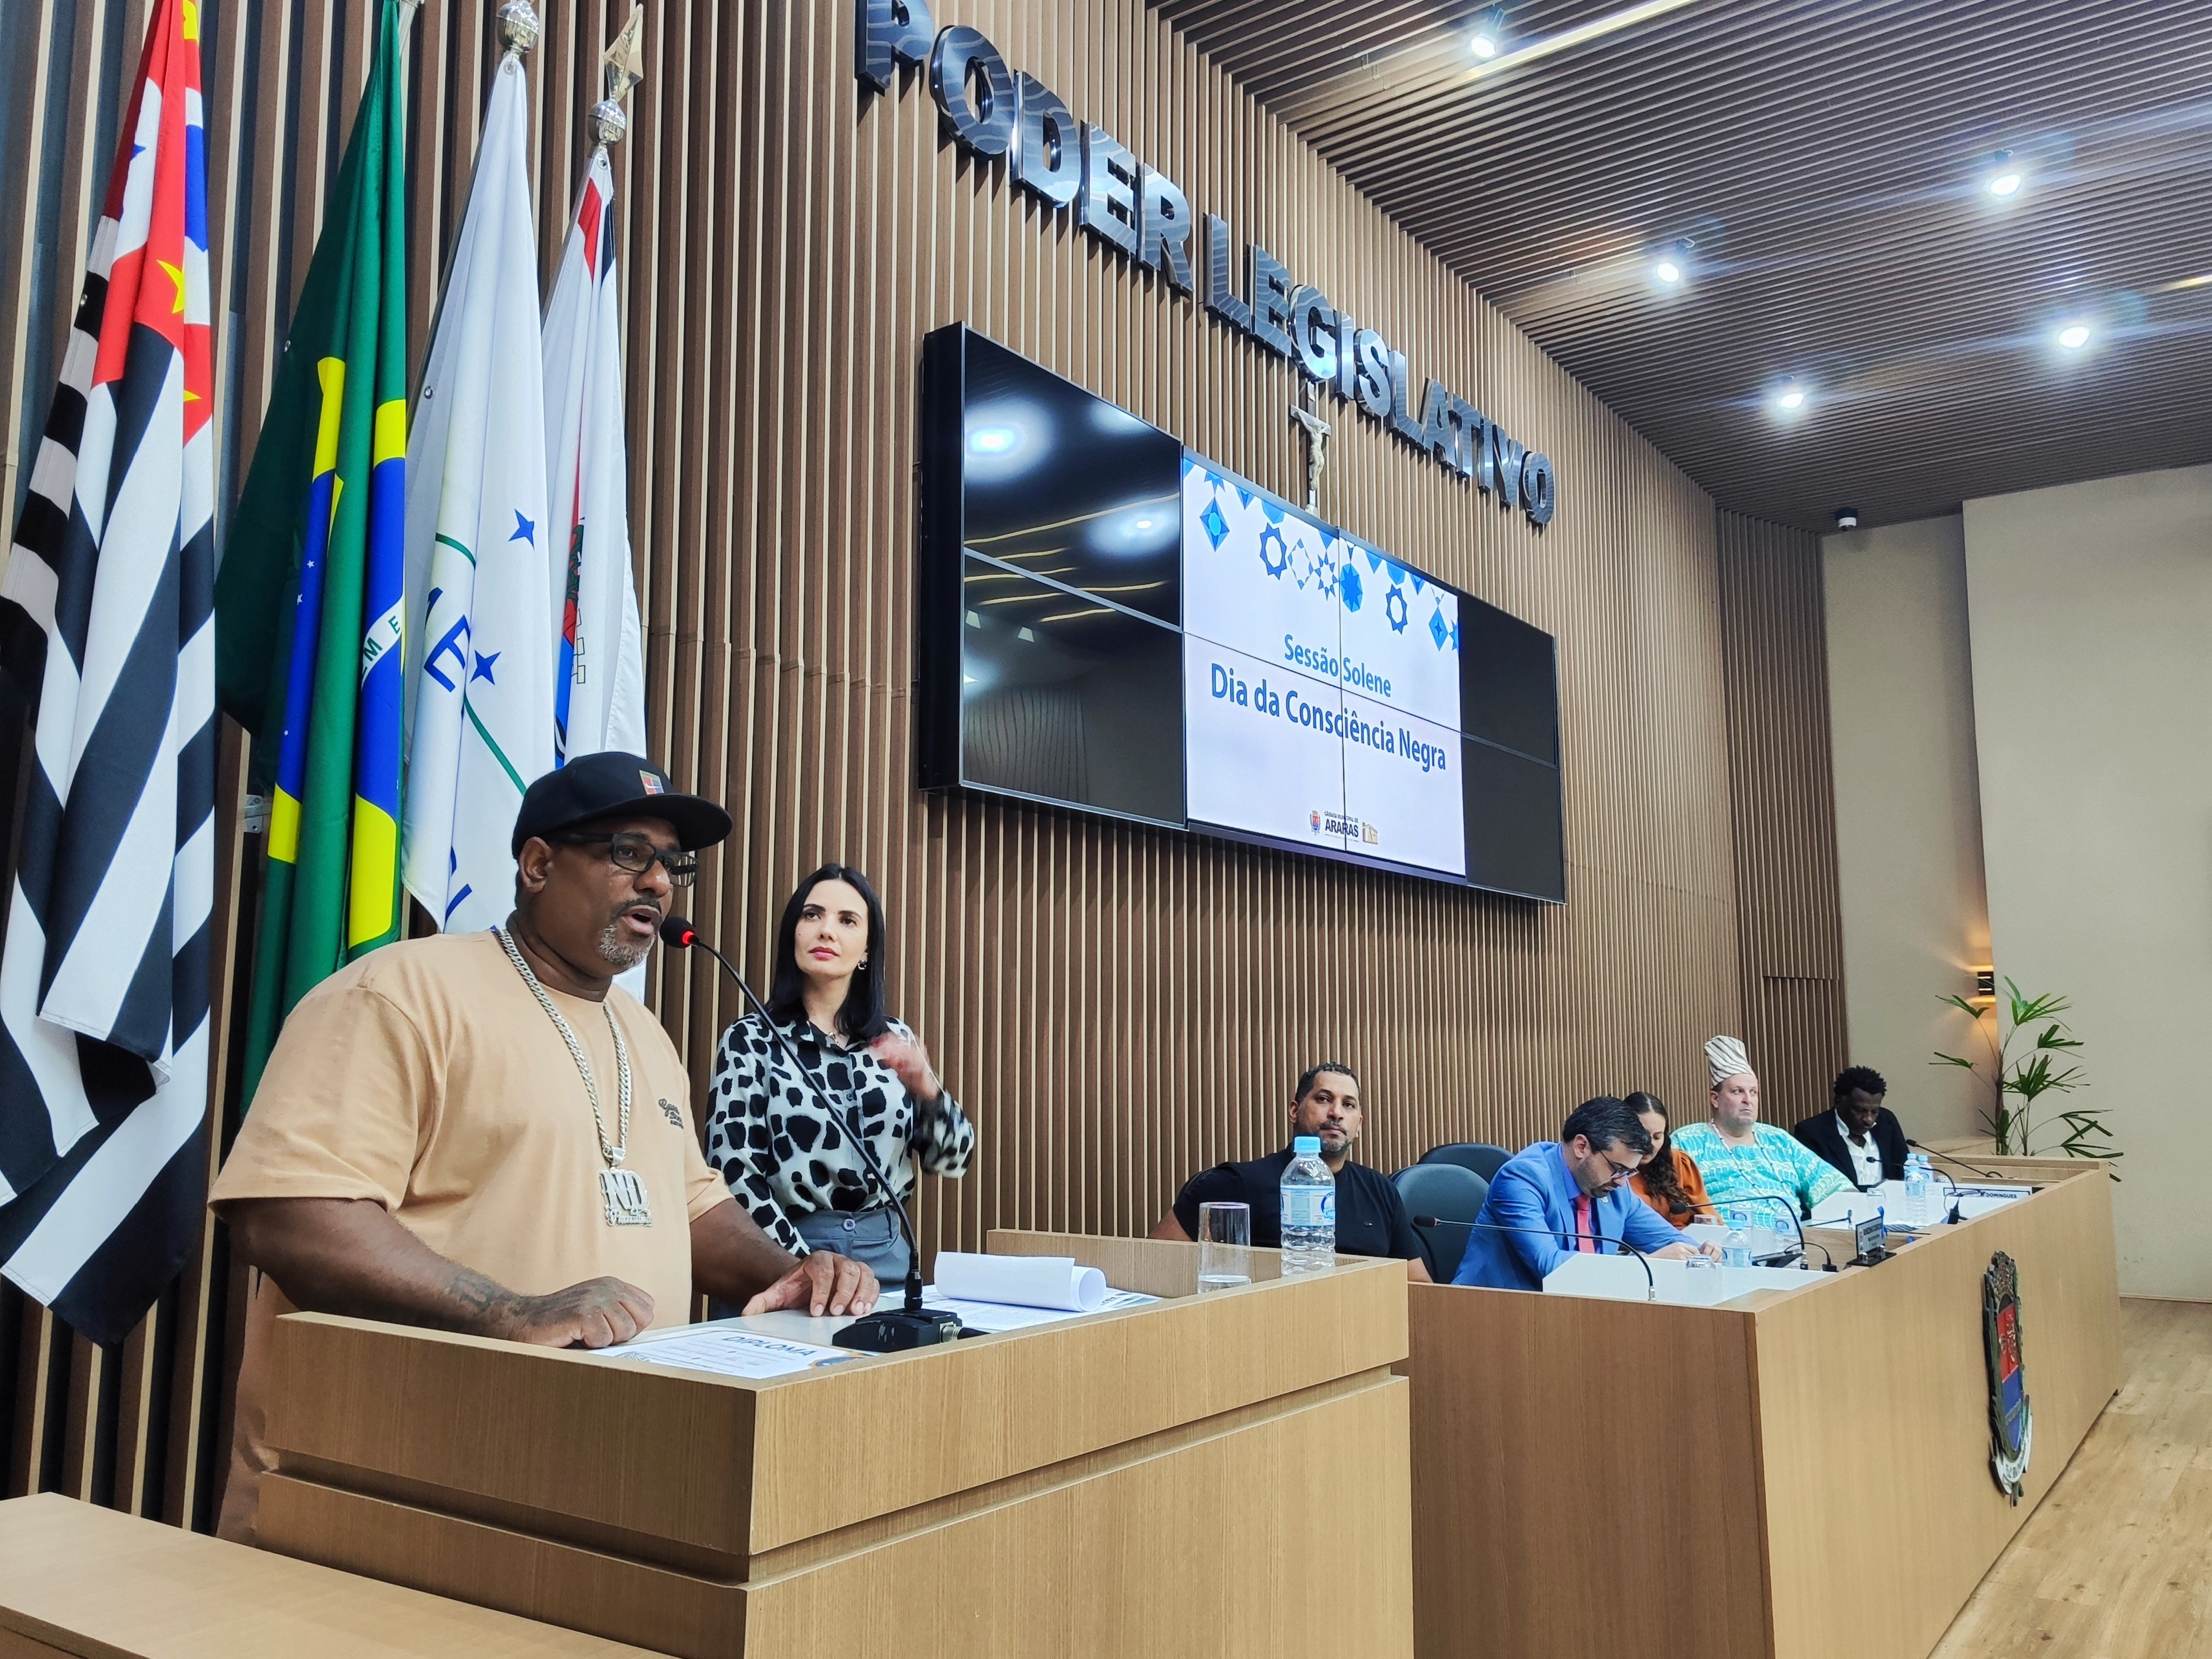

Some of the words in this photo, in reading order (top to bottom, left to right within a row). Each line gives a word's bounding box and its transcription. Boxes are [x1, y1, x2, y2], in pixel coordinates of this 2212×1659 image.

[854, 0, 1194, 293] PODER
[1203, 213, 1555, 525] LEGISLATIVO
[1284, 634, 1339, 677] Sessão
[1343, 657, 1391, 697] Solene
[1212, 663, 1248, 707] Dia
[1254, 678, 1280, 717] da
[1285, 690, 1395, 754] Consciência
[1399, 727, 1446, 772] Negra
[1325, 818, 1359, 838] ARARAS
[721, 1336, 818, 1356] DIPLOMA
